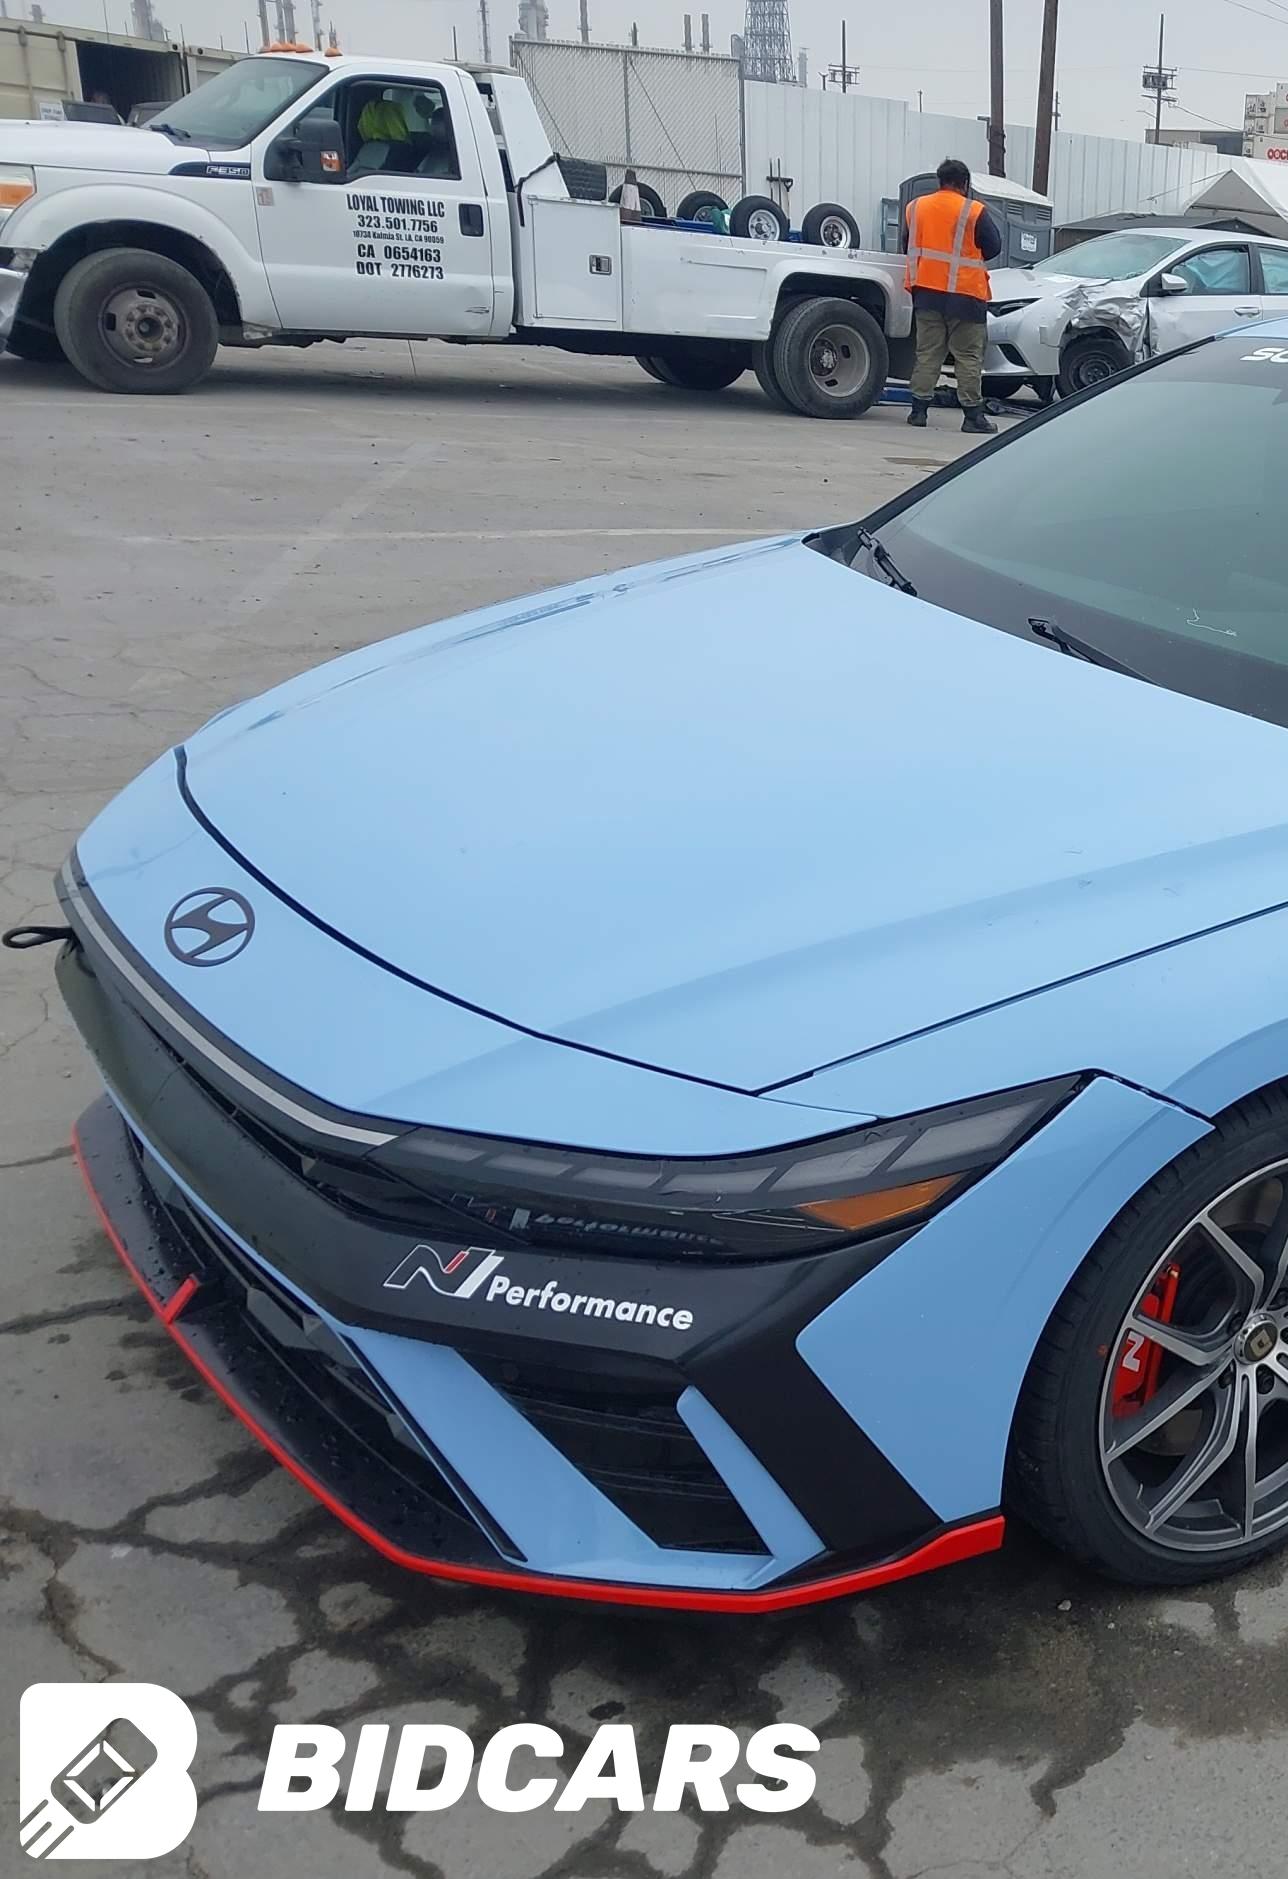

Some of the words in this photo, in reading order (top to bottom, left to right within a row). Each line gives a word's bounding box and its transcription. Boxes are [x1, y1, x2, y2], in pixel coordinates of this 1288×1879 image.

[346, 193, 379, 212] LOYAL
[380, 196, 425, 216] TOWING
[427, 200, 445, 218] LLC
[357, 214, 438, 233] 323.501.7756
[372, 231, 395, 241] Kalmia
[357, 243, 375, 258] CA
[384, 245, 441, 263] 0654163
[356, 261, 382, 276] DOT
[391, 263, 444, 280] 2776273
[486, 1275, 694, 1331] Performance
